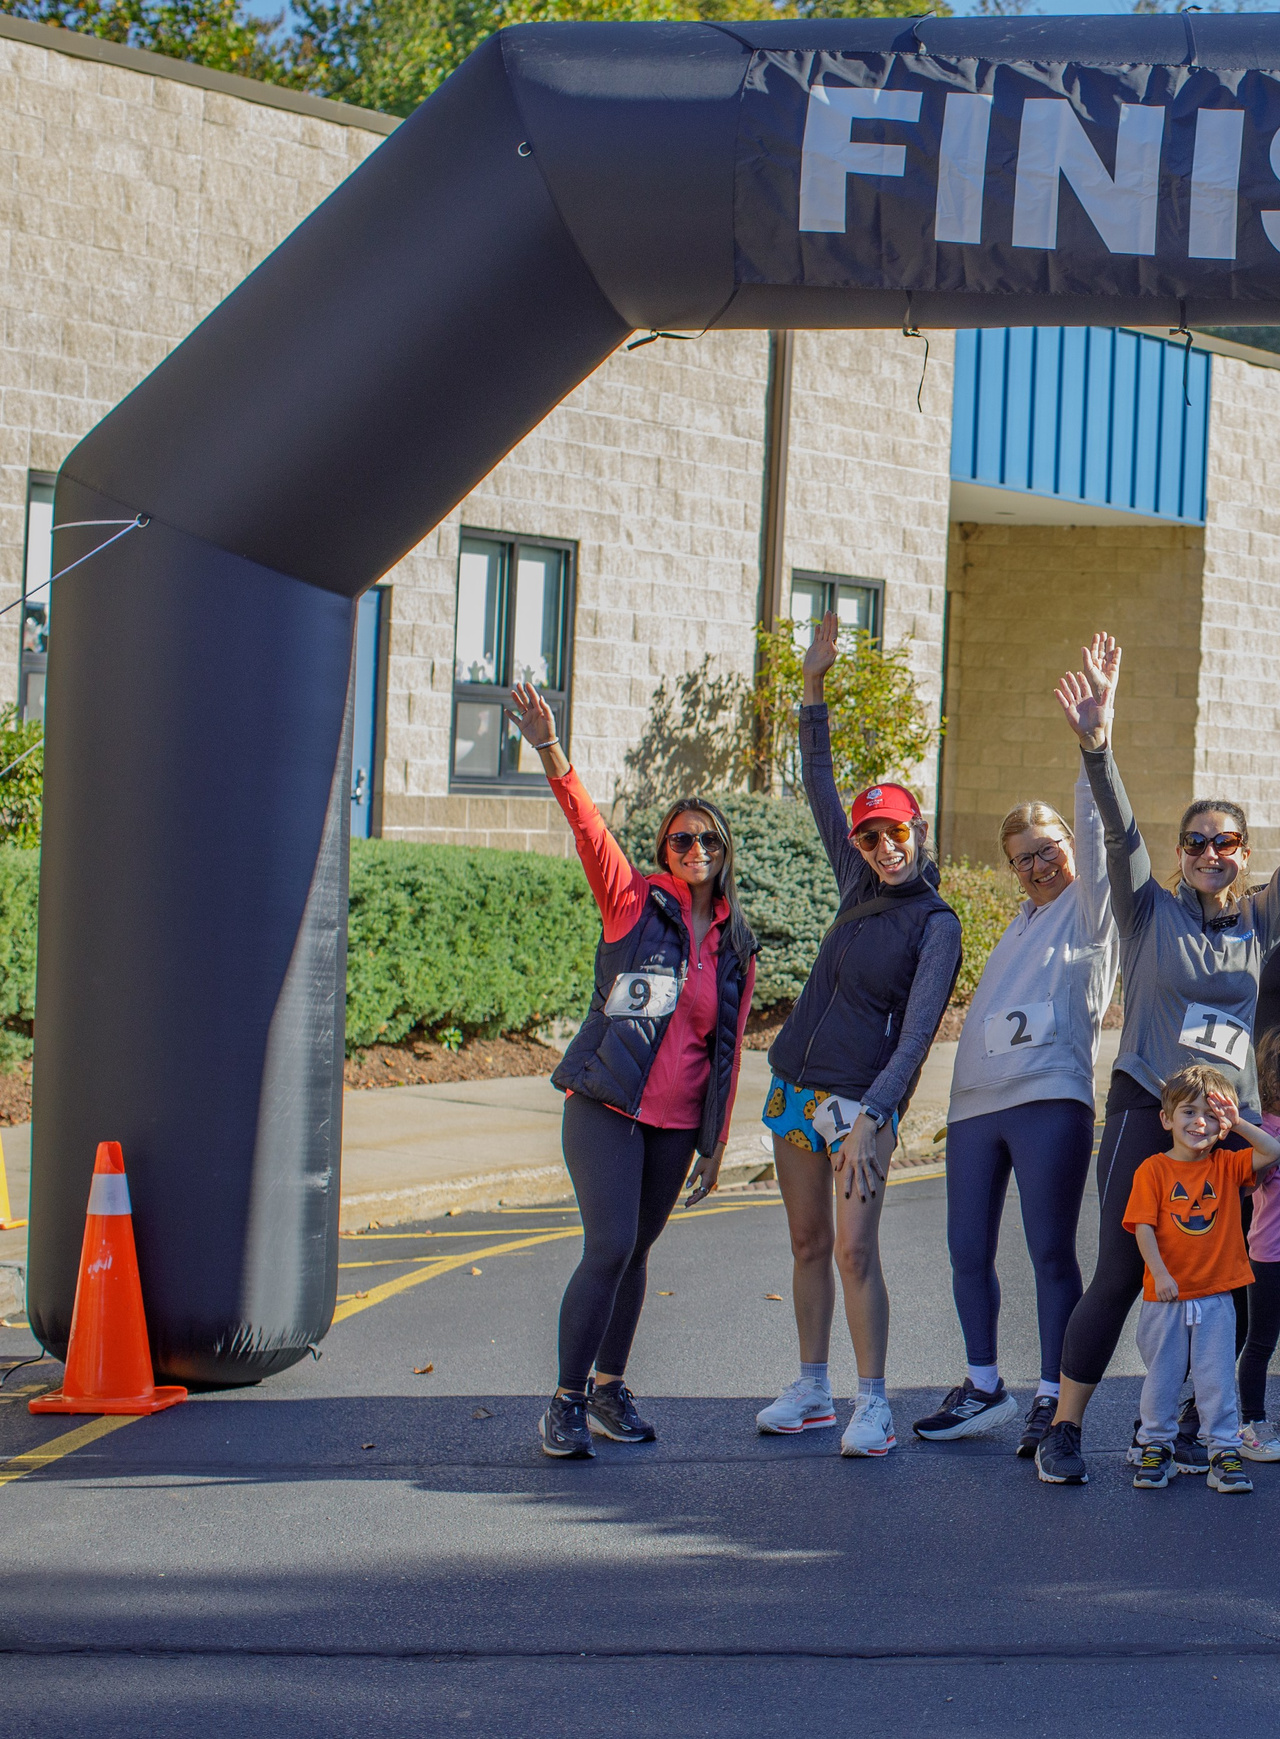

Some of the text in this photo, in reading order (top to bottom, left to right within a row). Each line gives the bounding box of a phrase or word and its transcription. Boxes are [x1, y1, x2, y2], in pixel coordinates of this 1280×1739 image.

[628, 979, 651, 1011] 9
[1006, 1011, 1032, 1046] 2
[1195, 1014, 1244, 1055] 17
[827, 1100, 851, 1134] 1
